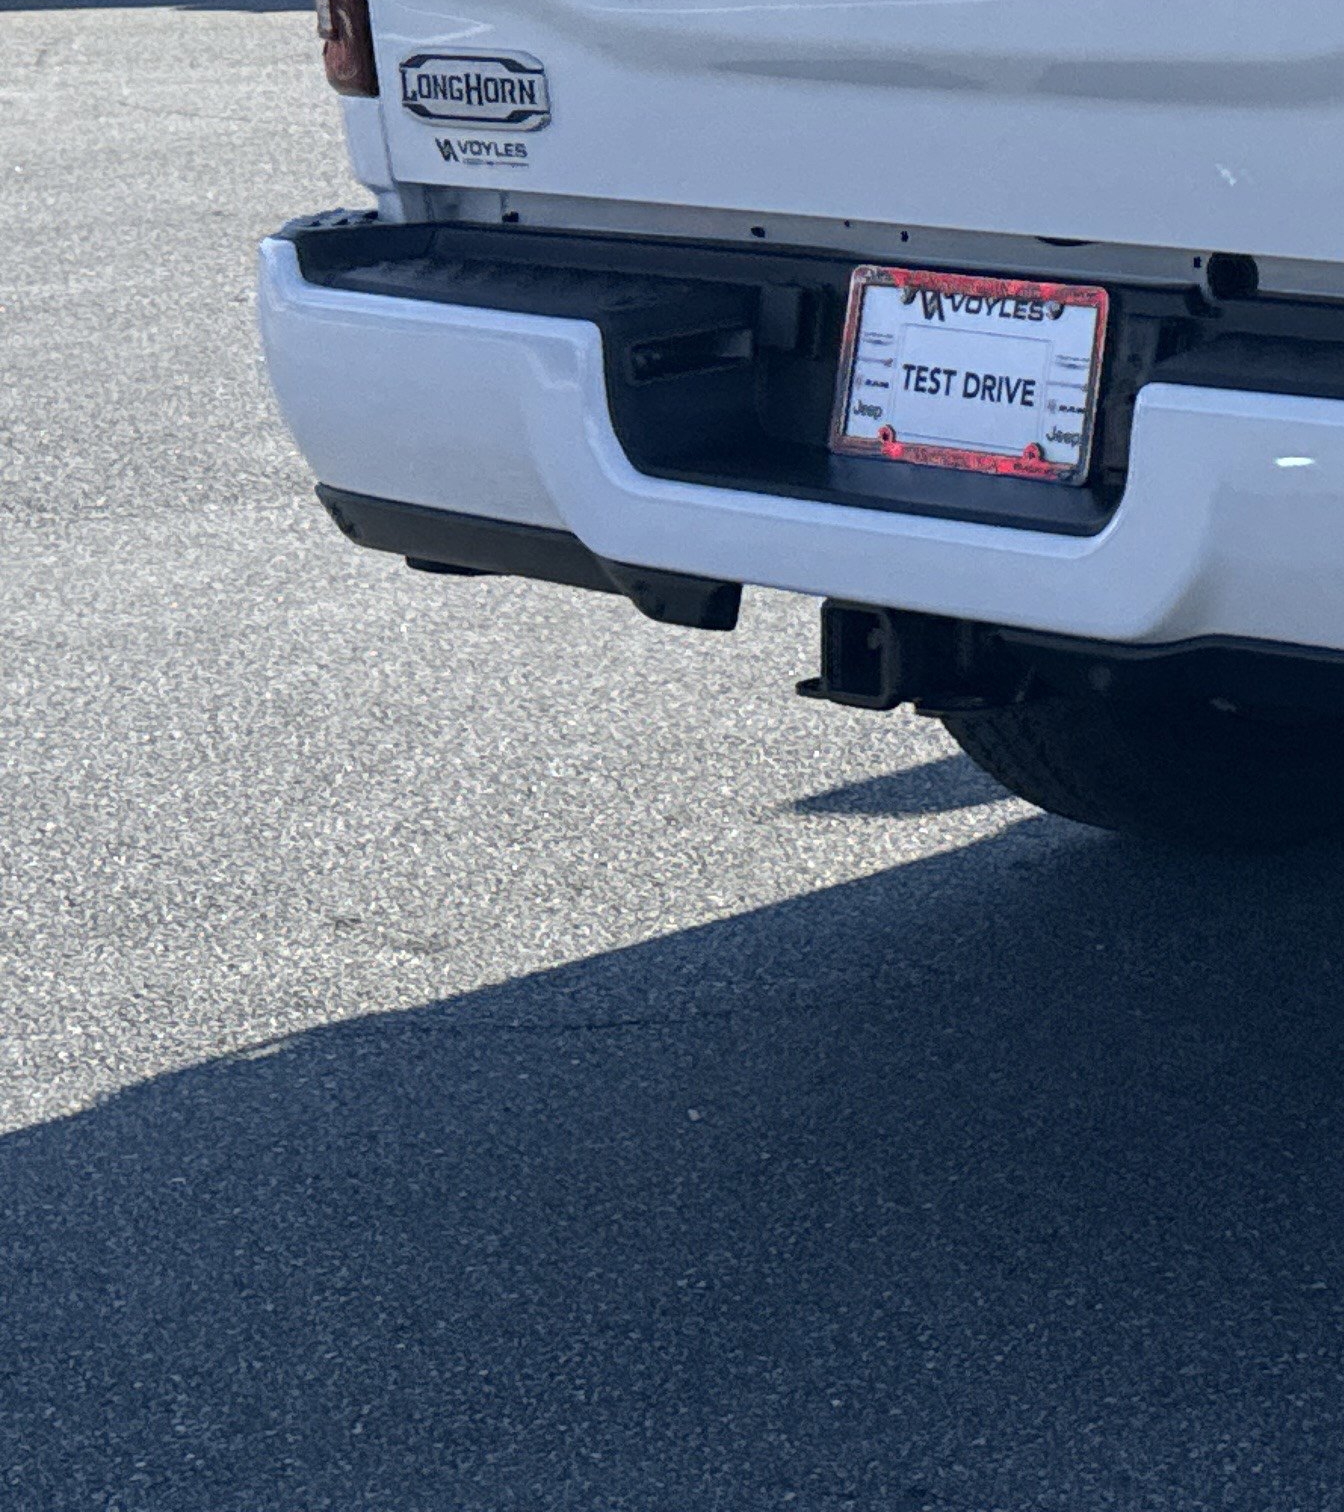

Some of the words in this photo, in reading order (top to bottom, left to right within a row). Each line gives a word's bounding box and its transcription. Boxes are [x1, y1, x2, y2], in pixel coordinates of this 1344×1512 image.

[458, 140, 528, 158] VOYLES
[944, 291, 1044, 322] VOYLES
[902, 363, 958, 397] TEST
[962, 371, 1036, 407] DRIVE
